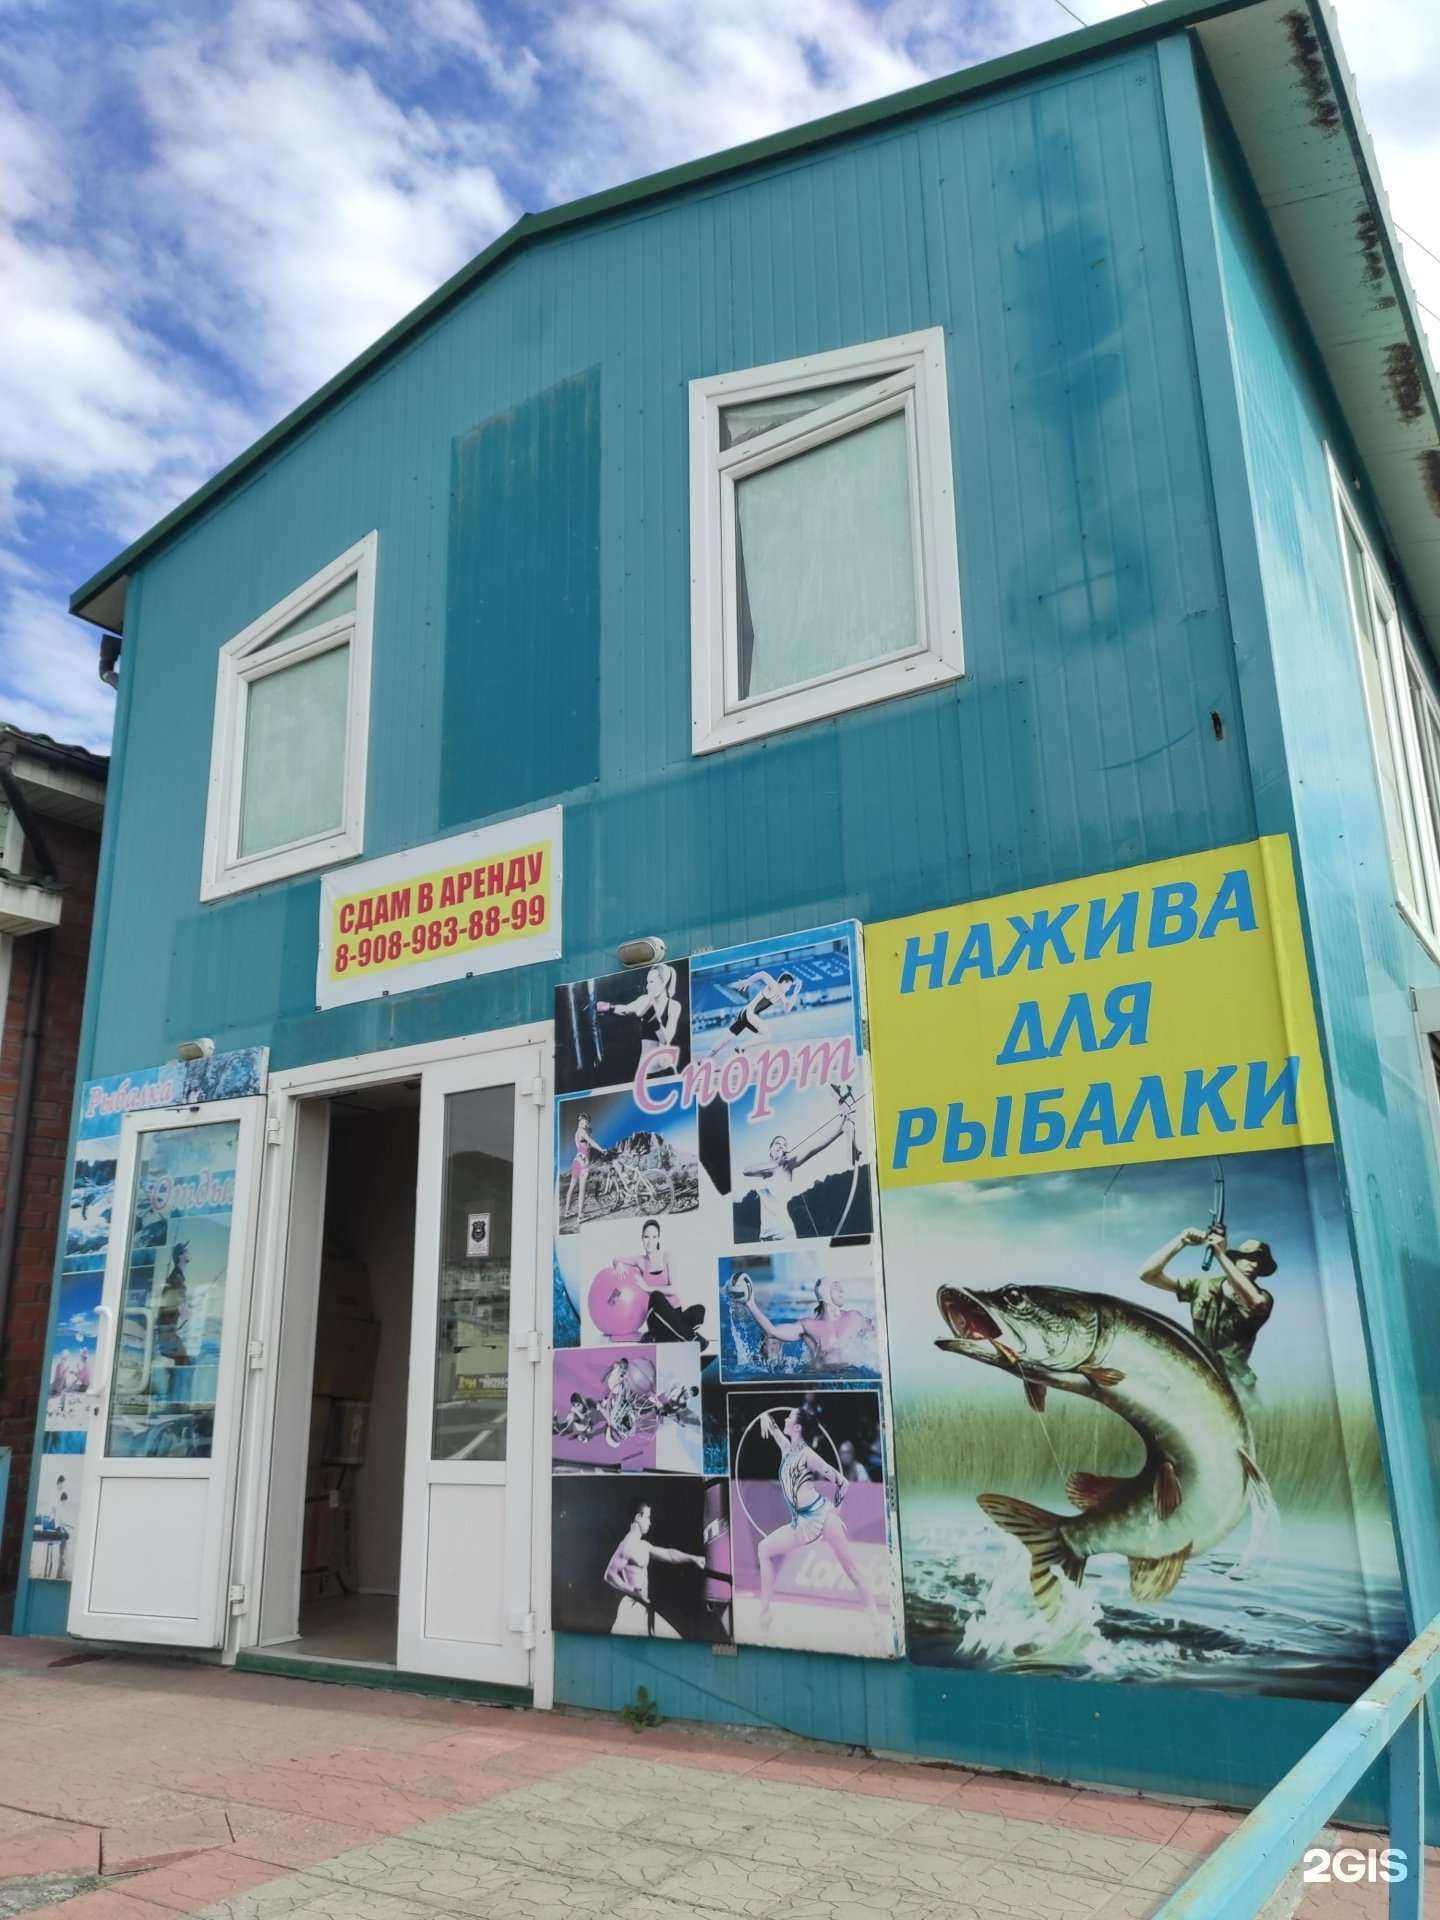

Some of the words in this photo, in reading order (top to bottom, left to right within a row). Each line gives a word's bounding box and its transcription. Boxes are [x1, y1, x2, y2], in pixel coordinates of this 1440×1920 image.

[335, 895, 545, 973] 8-908-983-88-99
[339, 887, 411, 935] СДАМ
[418, 882, 434, 914] В
[440, 851, 544, 909] АРЕНДУ
[899, 869, 1259, 993] НАЖИВА
[995, 981, 1152, 1065] ДЛЯ
[634, 1036, 855, 1121] Спорт
[892, 1055, 1301, 1169] РЫБАЛКИ
[150, 1168, 234, 1210] Отды
